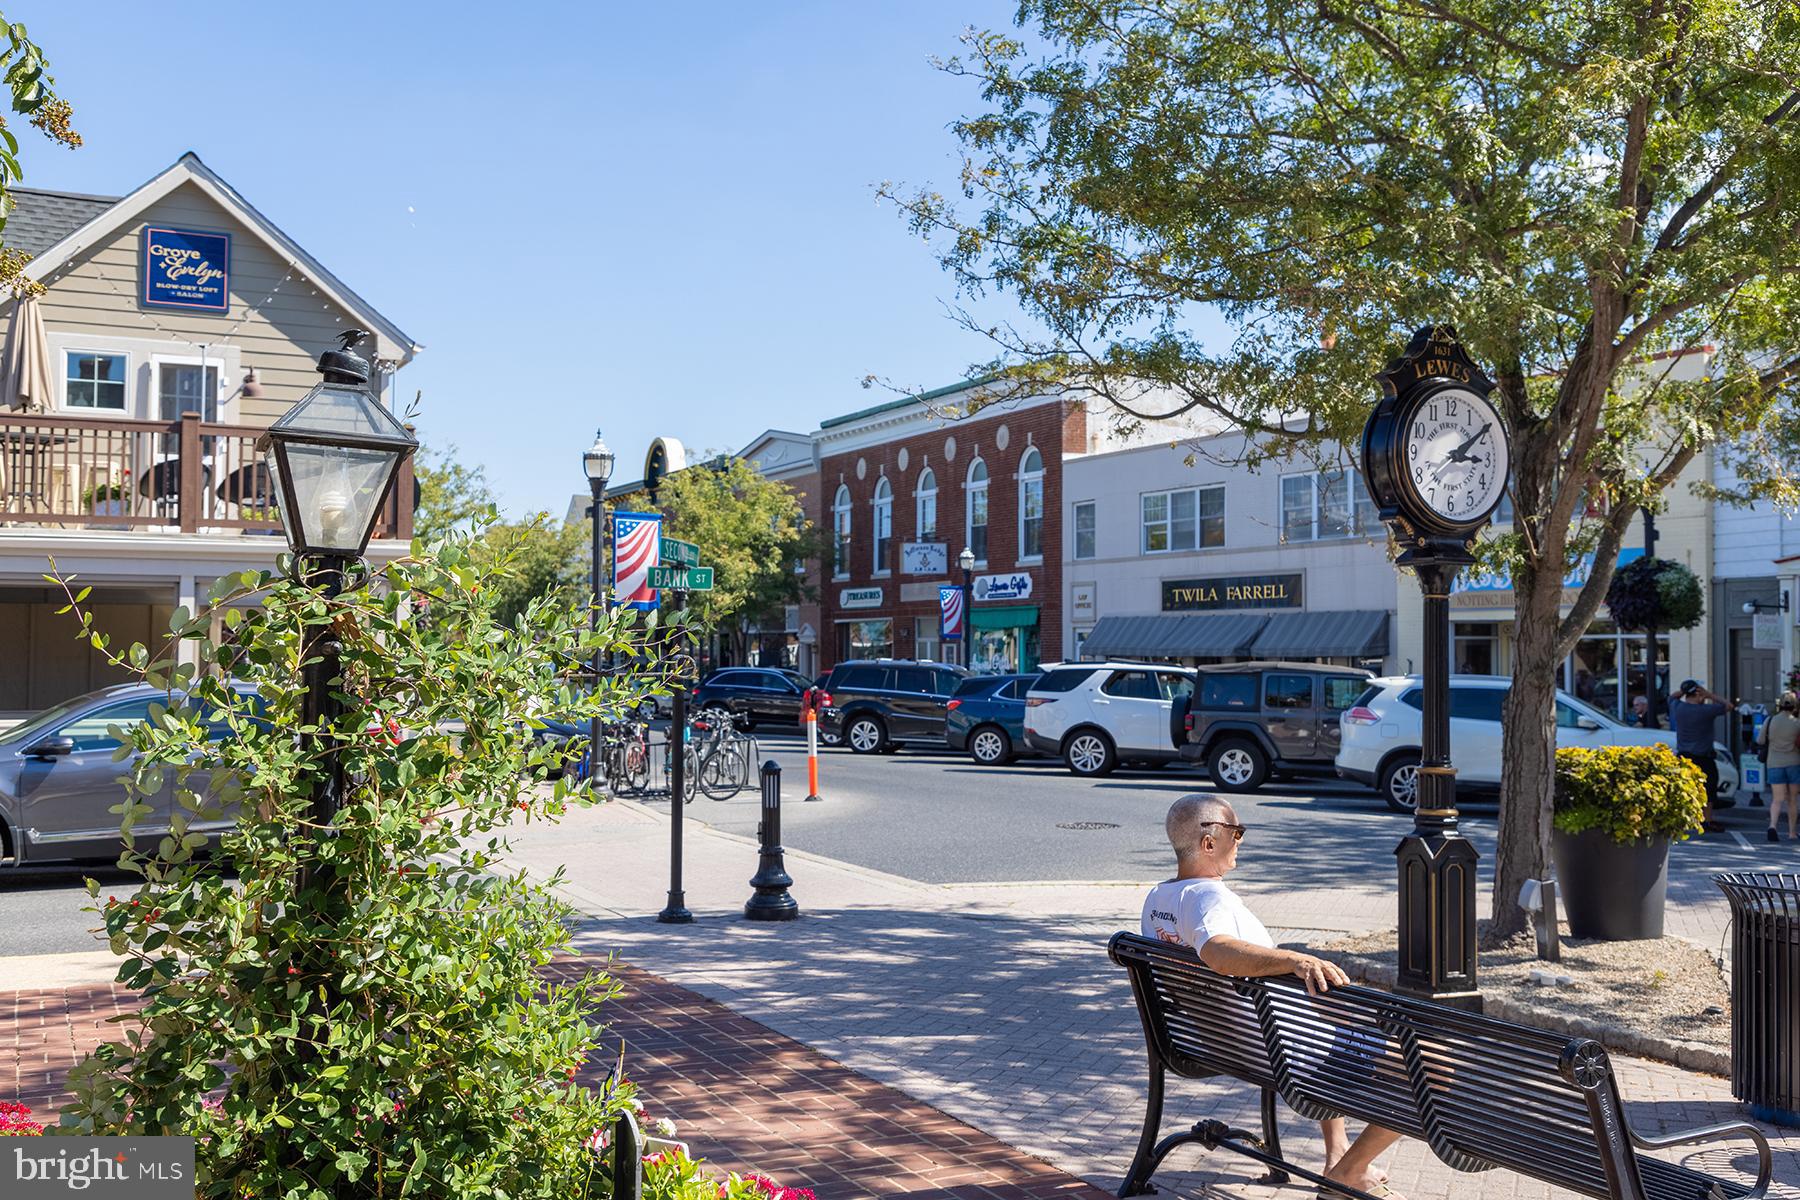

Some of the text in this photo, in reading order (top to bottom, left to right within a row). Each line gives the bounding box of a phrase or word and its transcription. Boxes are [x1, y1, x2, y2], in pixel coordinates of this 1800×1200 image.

[150, 244, 201, 259] Grove
[165, 256, 224, 285] Evelyn
[1434, 346, 1451, 356] 1631
[1413, 359, 1471, 383] LEWES
[1429, 404, 1438, 421] 11
[1445, 400, 1457, 416] 12
[1467, 409, 1472, 426] 1
[1414, 422, 1425, 439] 10
[1427, 427, 1438, 442] THE
[1440, 422, 1458, 431] FIRST
[1410, 444, 1417, 461] 9
[1484, 452, 1491, 468] 3
[1415, 467, 1423, 484] 8
[1478, 473, 1486, 490] 4
[1443, 481, 1463, 492] FIRST
[1427, 488, 1435, 505] 7
[1447, 495, 1454, 512] 6
[1466, 490, 1474, 507] 5
[654, 569, 706, 588] BANK ST
[1172, 584, 1288, 602] TWILA FARRELL
[1456, 594, 1498, 607] NOTTING
